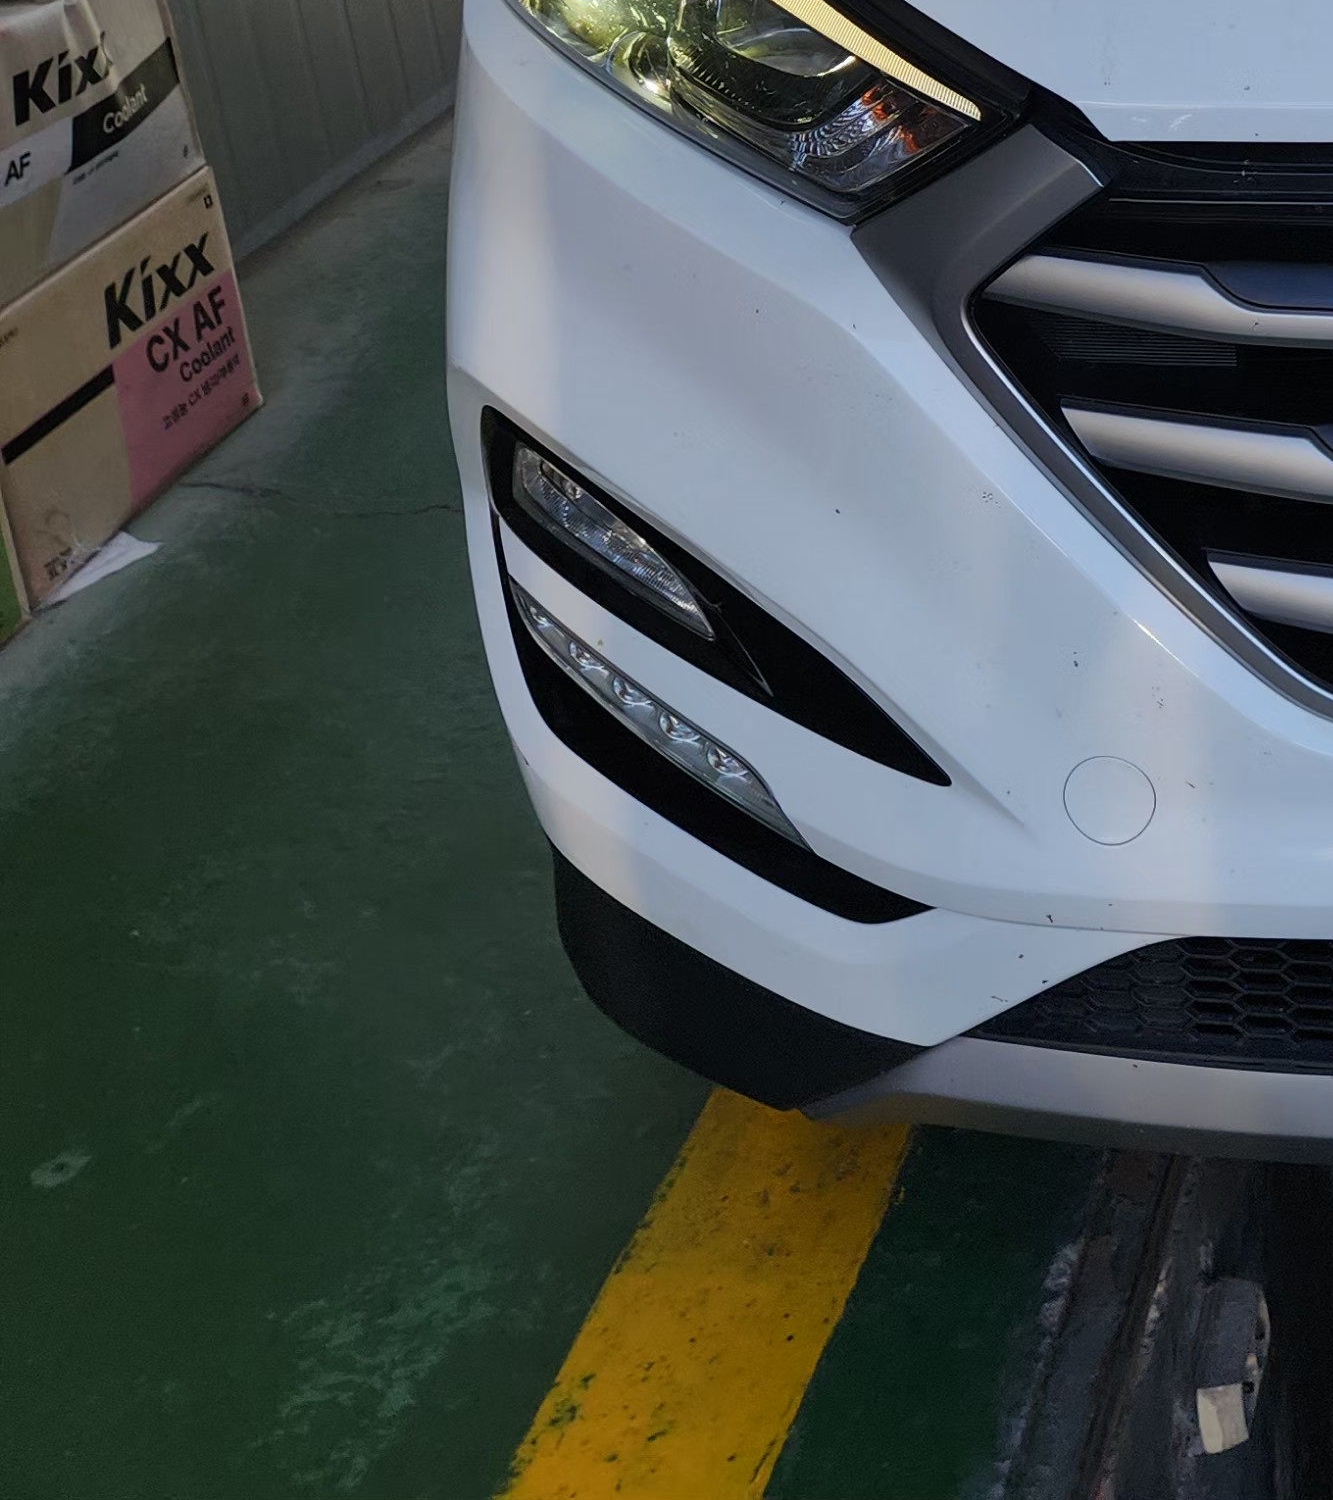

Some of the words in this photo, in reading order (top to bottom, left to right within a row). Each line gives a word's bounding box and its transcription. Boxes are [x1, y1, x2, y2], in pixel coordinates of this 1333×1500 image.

[4, 151, 32, 187] AF
[104, 231, 215, 350] Kixx
[145, 316, 190, 374] CX
[193, 285, 226, 343] AF
[179, 325, 236, 383] Coolant
